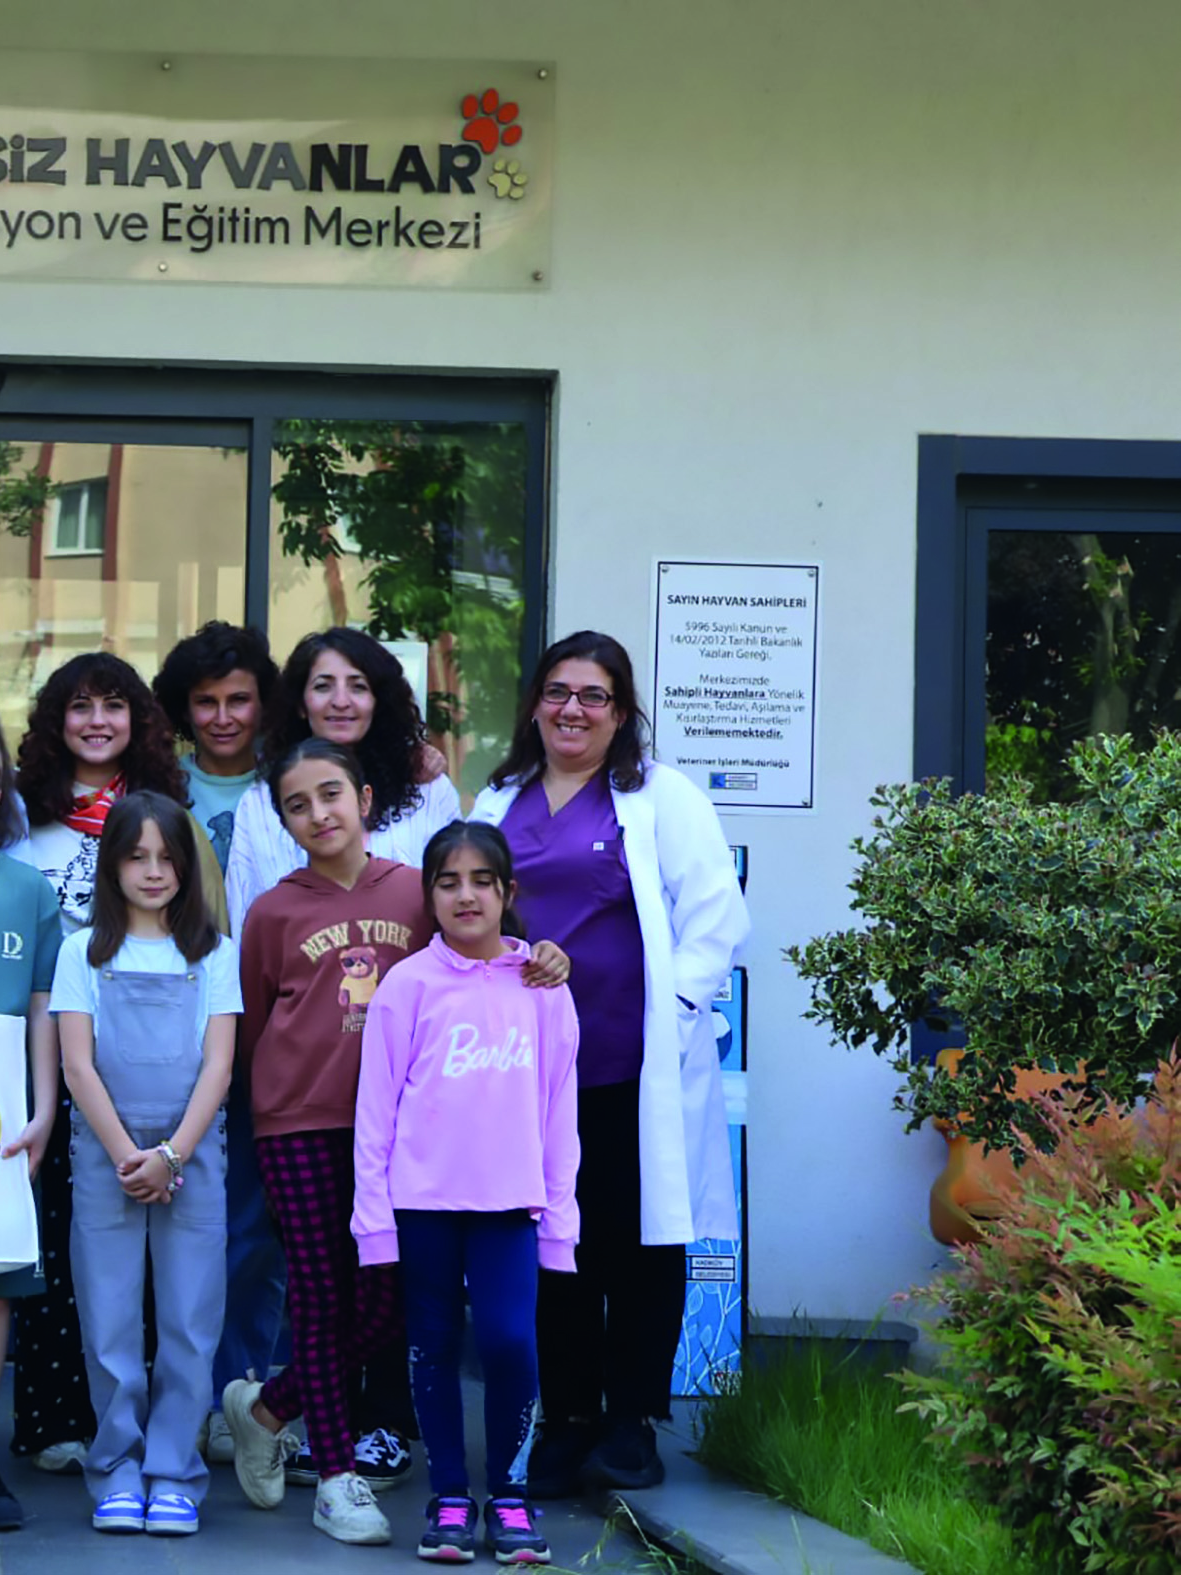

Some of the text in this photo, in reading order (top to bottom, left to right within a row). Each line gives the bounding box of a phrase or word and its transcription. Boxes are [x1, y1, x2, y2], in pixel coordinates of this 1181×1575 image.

[86, 138, 482, 194] HAYVANLAR
[94, 212, 149, 242] ve
[162, 202, 290, 253] Eğitim
[304, 205, 481, 249] Merkezi
[667, 595, 699, 606] SAYIN
[702, 596, 747, 607] HAYVAN
[741, 623, 773, 634] Kanun
[775, 625, 787, 634] ve
[699, 674, 769, 686] Merkezimizde
[664, 686, 702, 698] Sahipli
[704, 687, 765, 699] Hayvanlara
[793, 704, 805, 713] ve
[3, 931, 24, 955] D
[300, 919, 412, 963] NEW YORK
